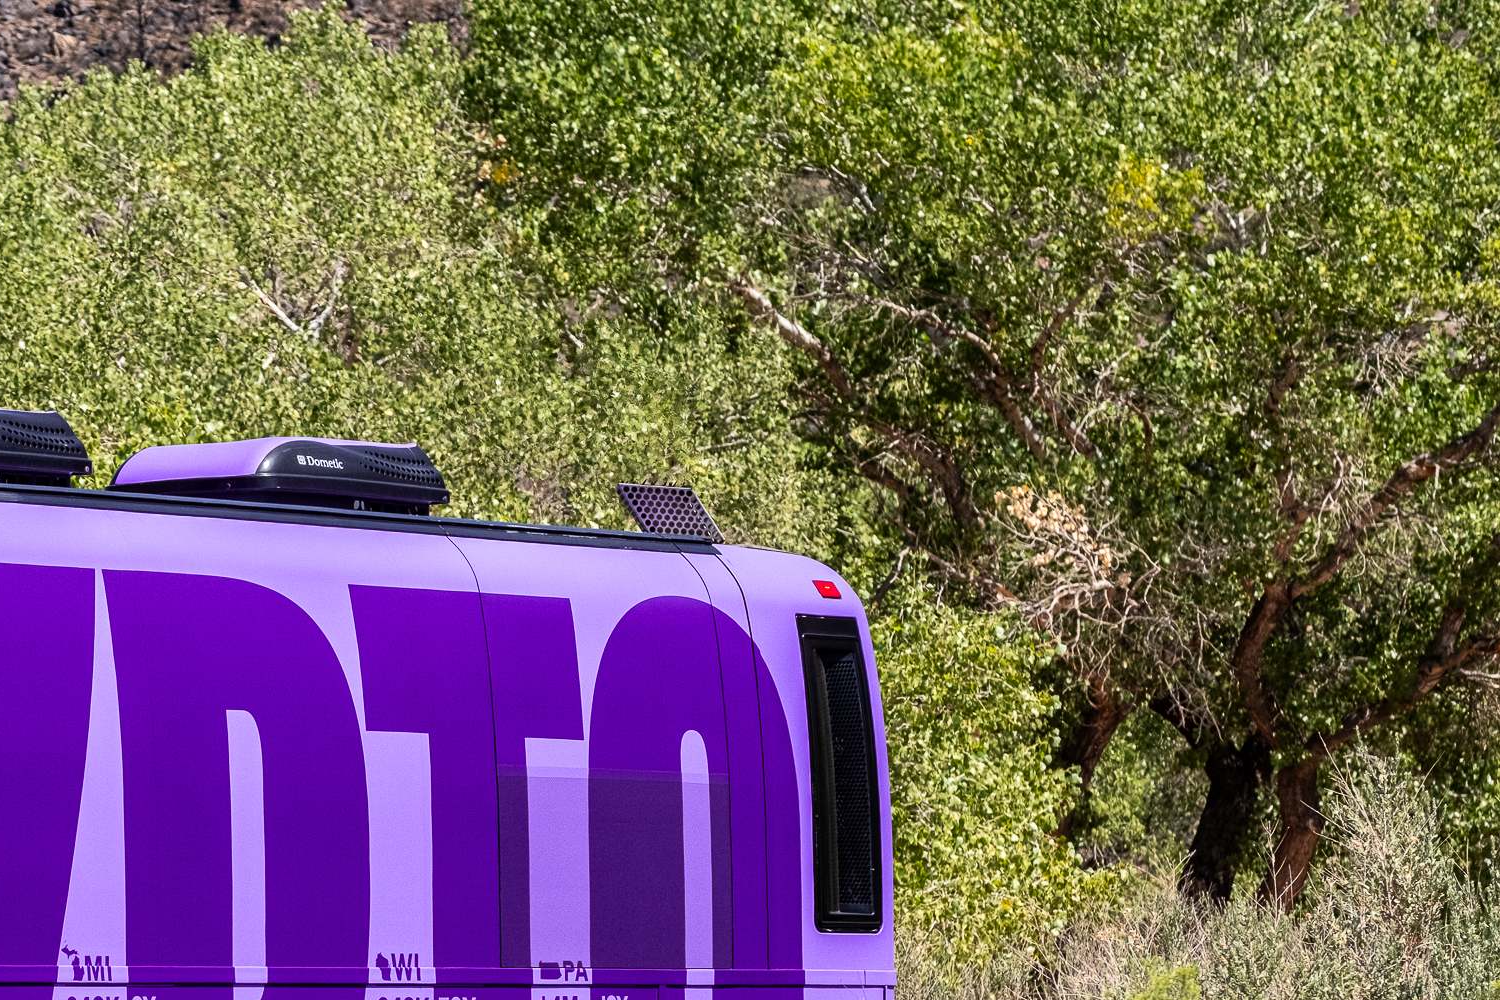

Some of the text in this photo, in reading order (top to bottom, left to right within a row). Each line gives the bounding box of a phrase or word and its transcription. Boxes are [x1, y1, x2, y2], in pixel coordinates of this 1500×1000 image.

[306, 455, 344, 470] Dometic
[84, 955, 113, 982] MI
[390, 953, 422, 982] WI
[562, 960, 589, 982] PA
